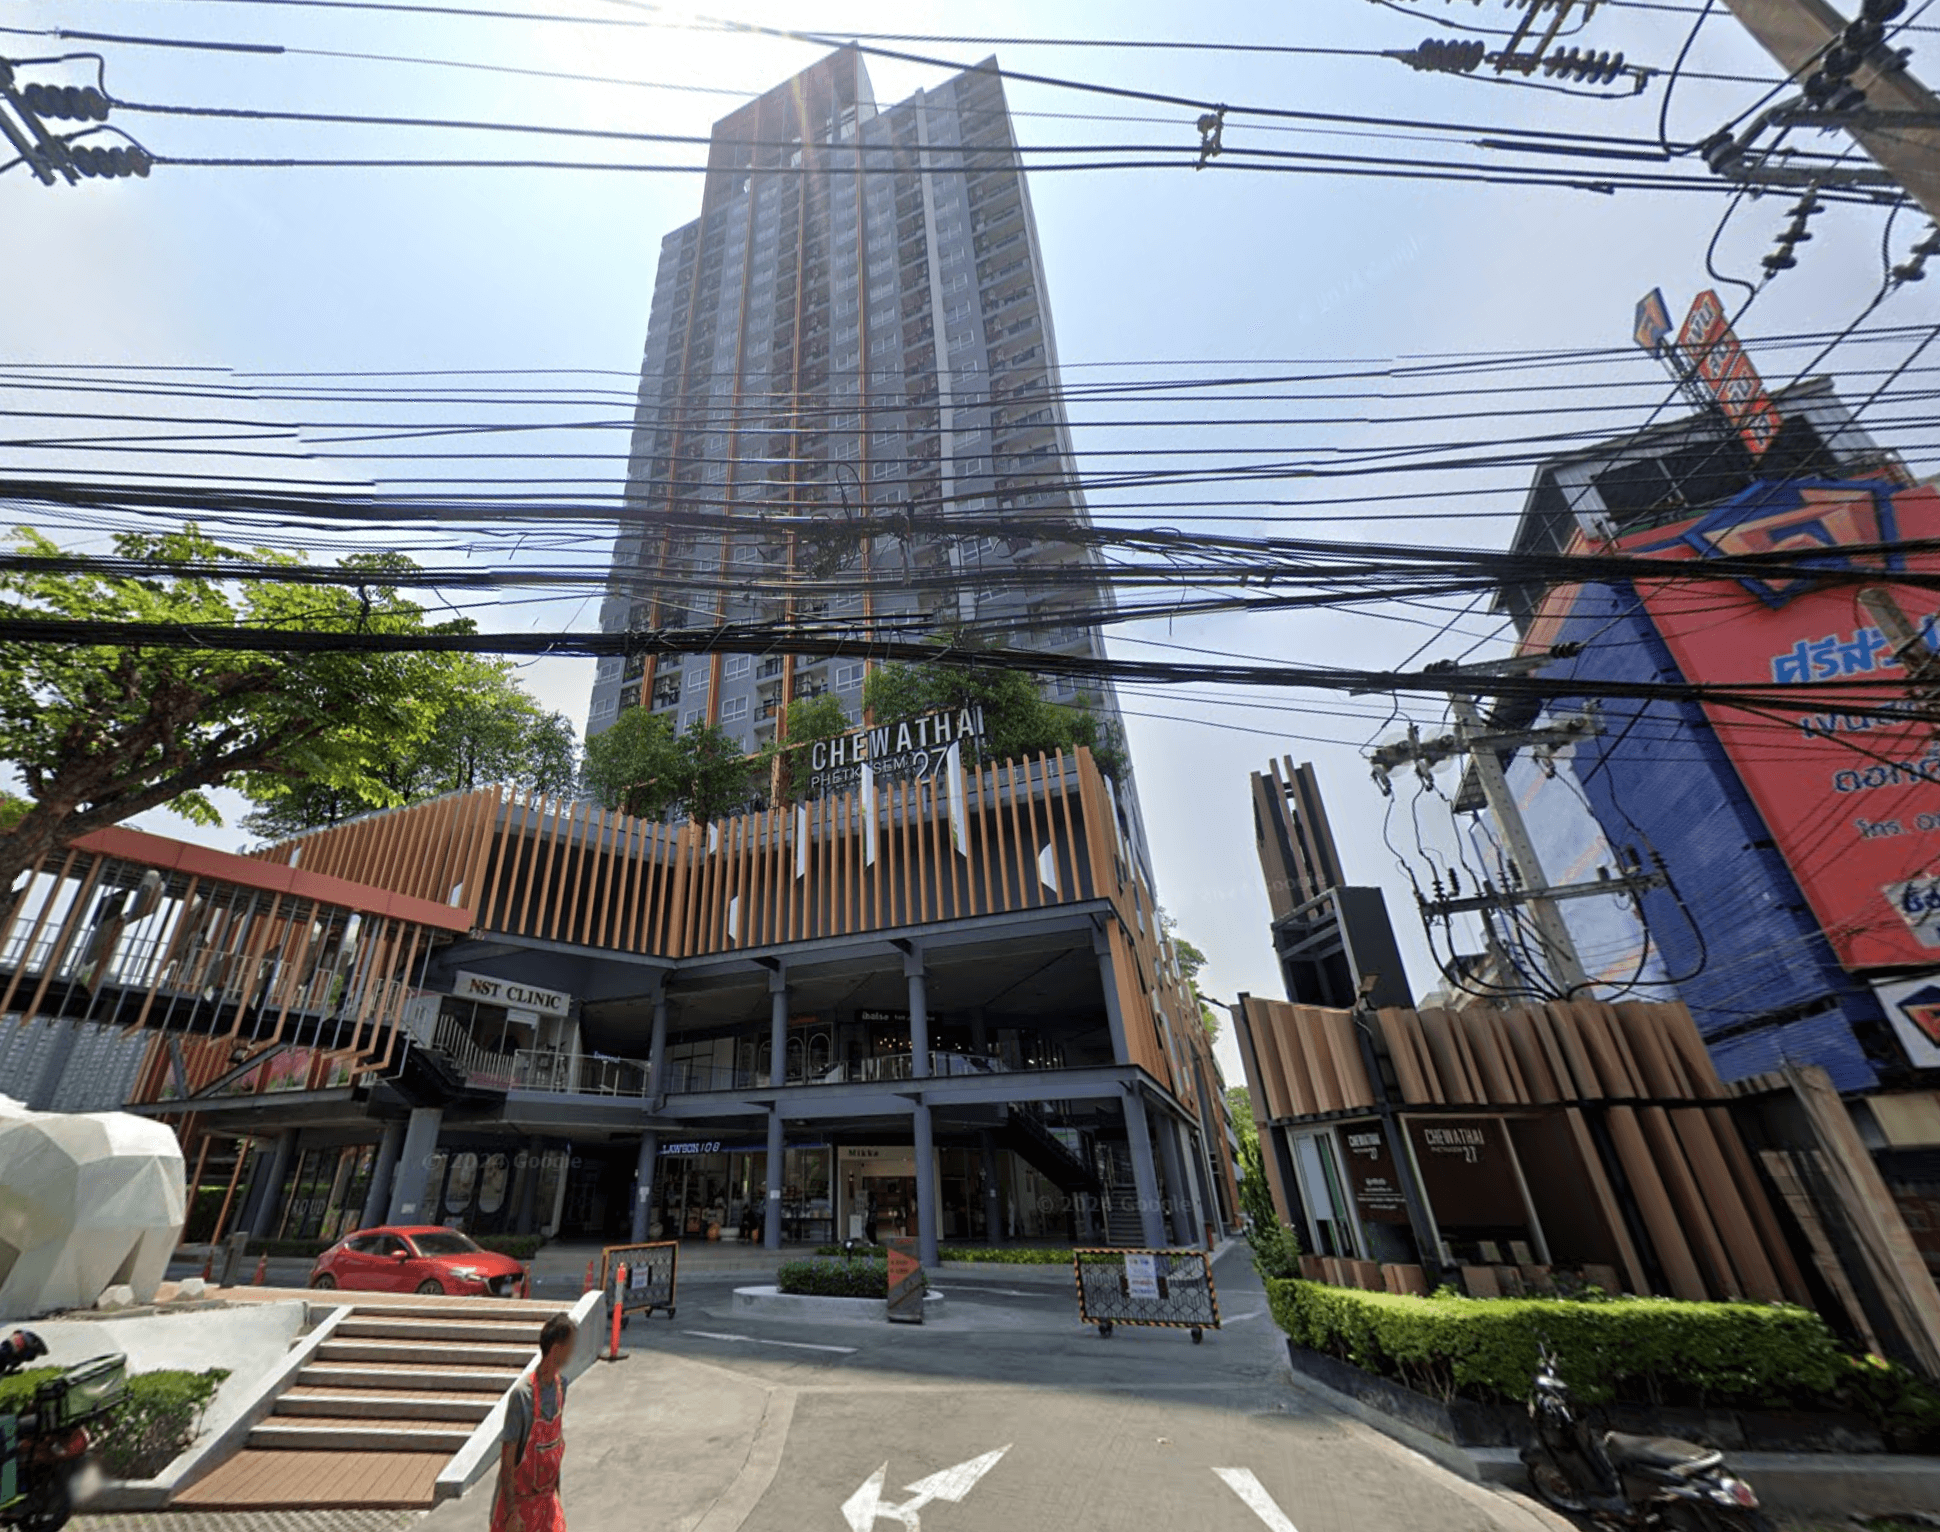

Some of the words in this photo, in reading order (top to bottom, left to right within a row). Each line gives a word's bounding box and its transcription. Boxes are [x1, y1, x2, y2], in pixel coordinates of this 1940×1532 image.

[812, 706, 984, 771] CHEWATHAI
[810, 757, 906, 788] PHETKSEM
[912, 746, 948, 785] 27
[469, 978, 501, 998] NST
[506, 986, 562, 1009] CLINIC
[700, 1141, 721, 1153] 108
